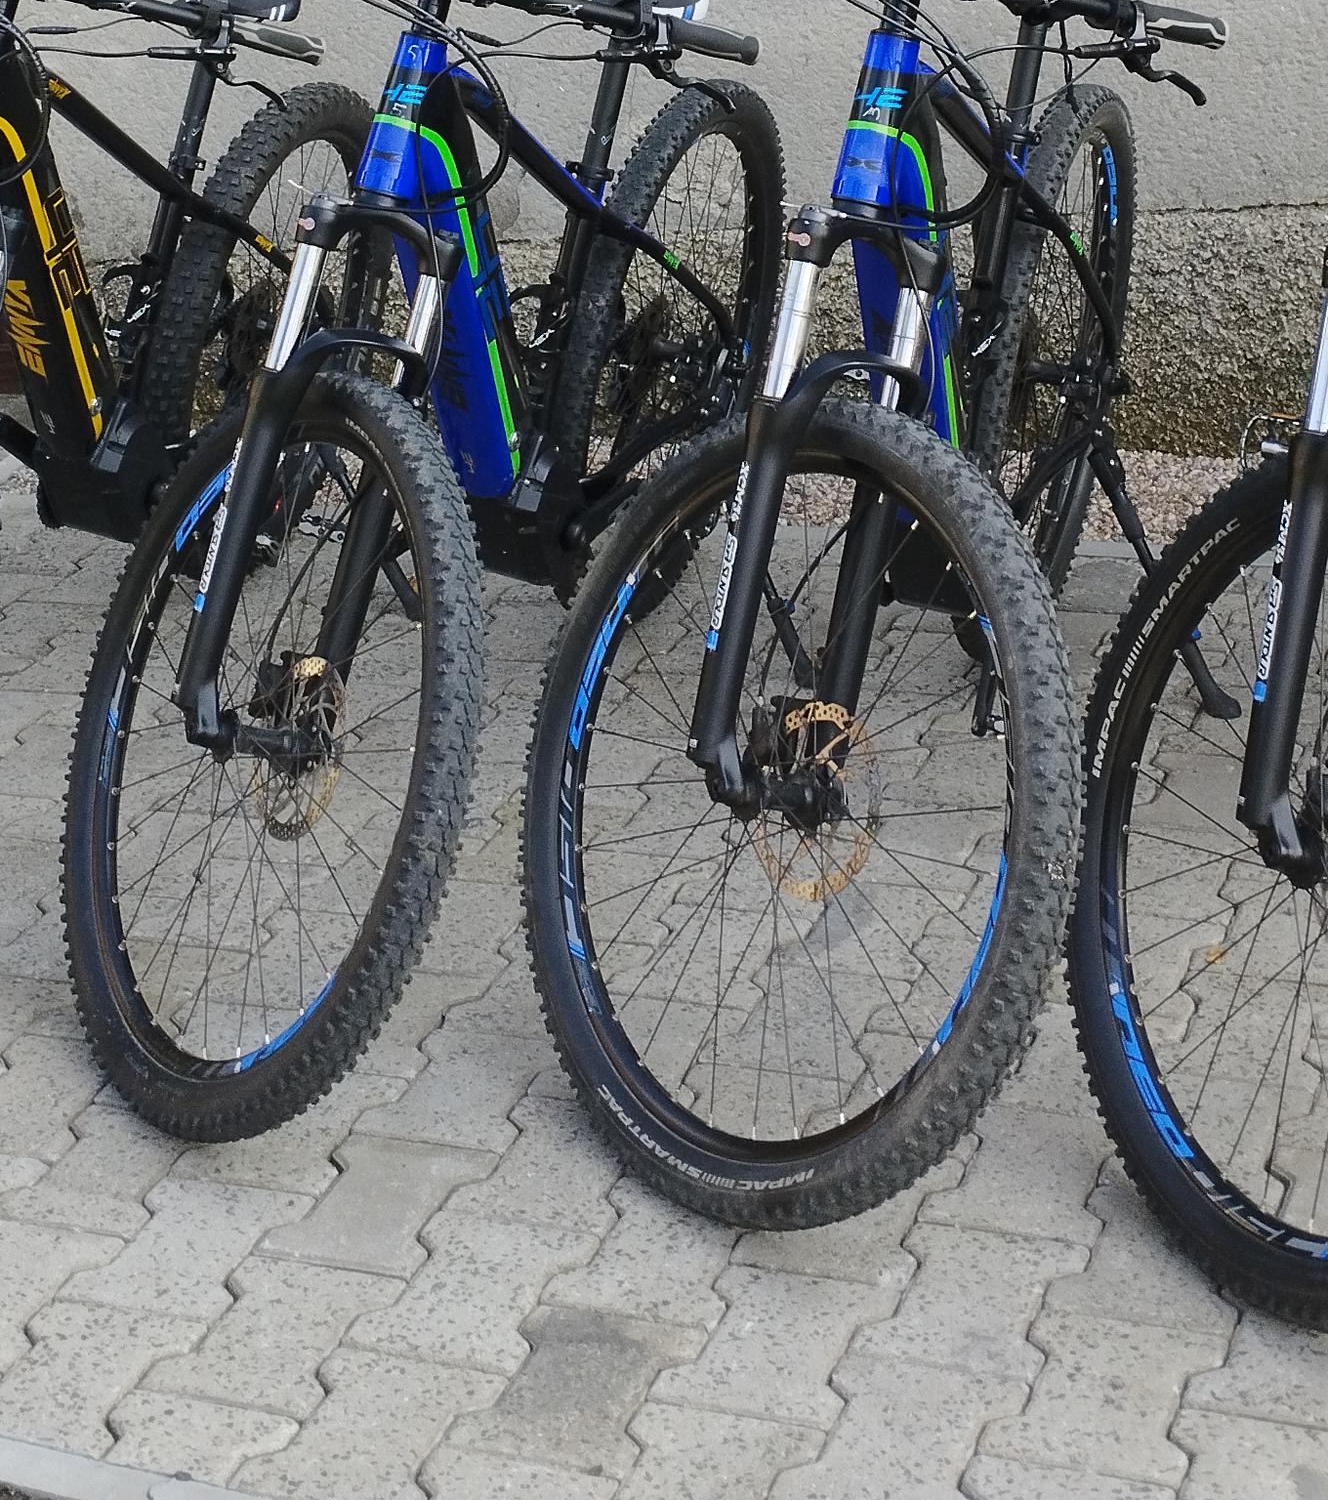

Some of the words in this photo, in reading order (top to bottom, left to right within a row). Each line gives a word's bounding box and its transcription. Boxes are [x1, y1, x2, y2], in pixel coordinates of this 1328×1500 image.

[1091, 678, 1127, 779] IMPAC
[1139, 518, 1242, 645] SMARTPAC
[595, 1083, 705, 1181] SMARTPAC
[734, 1167, 815, 1192] IMPAC
